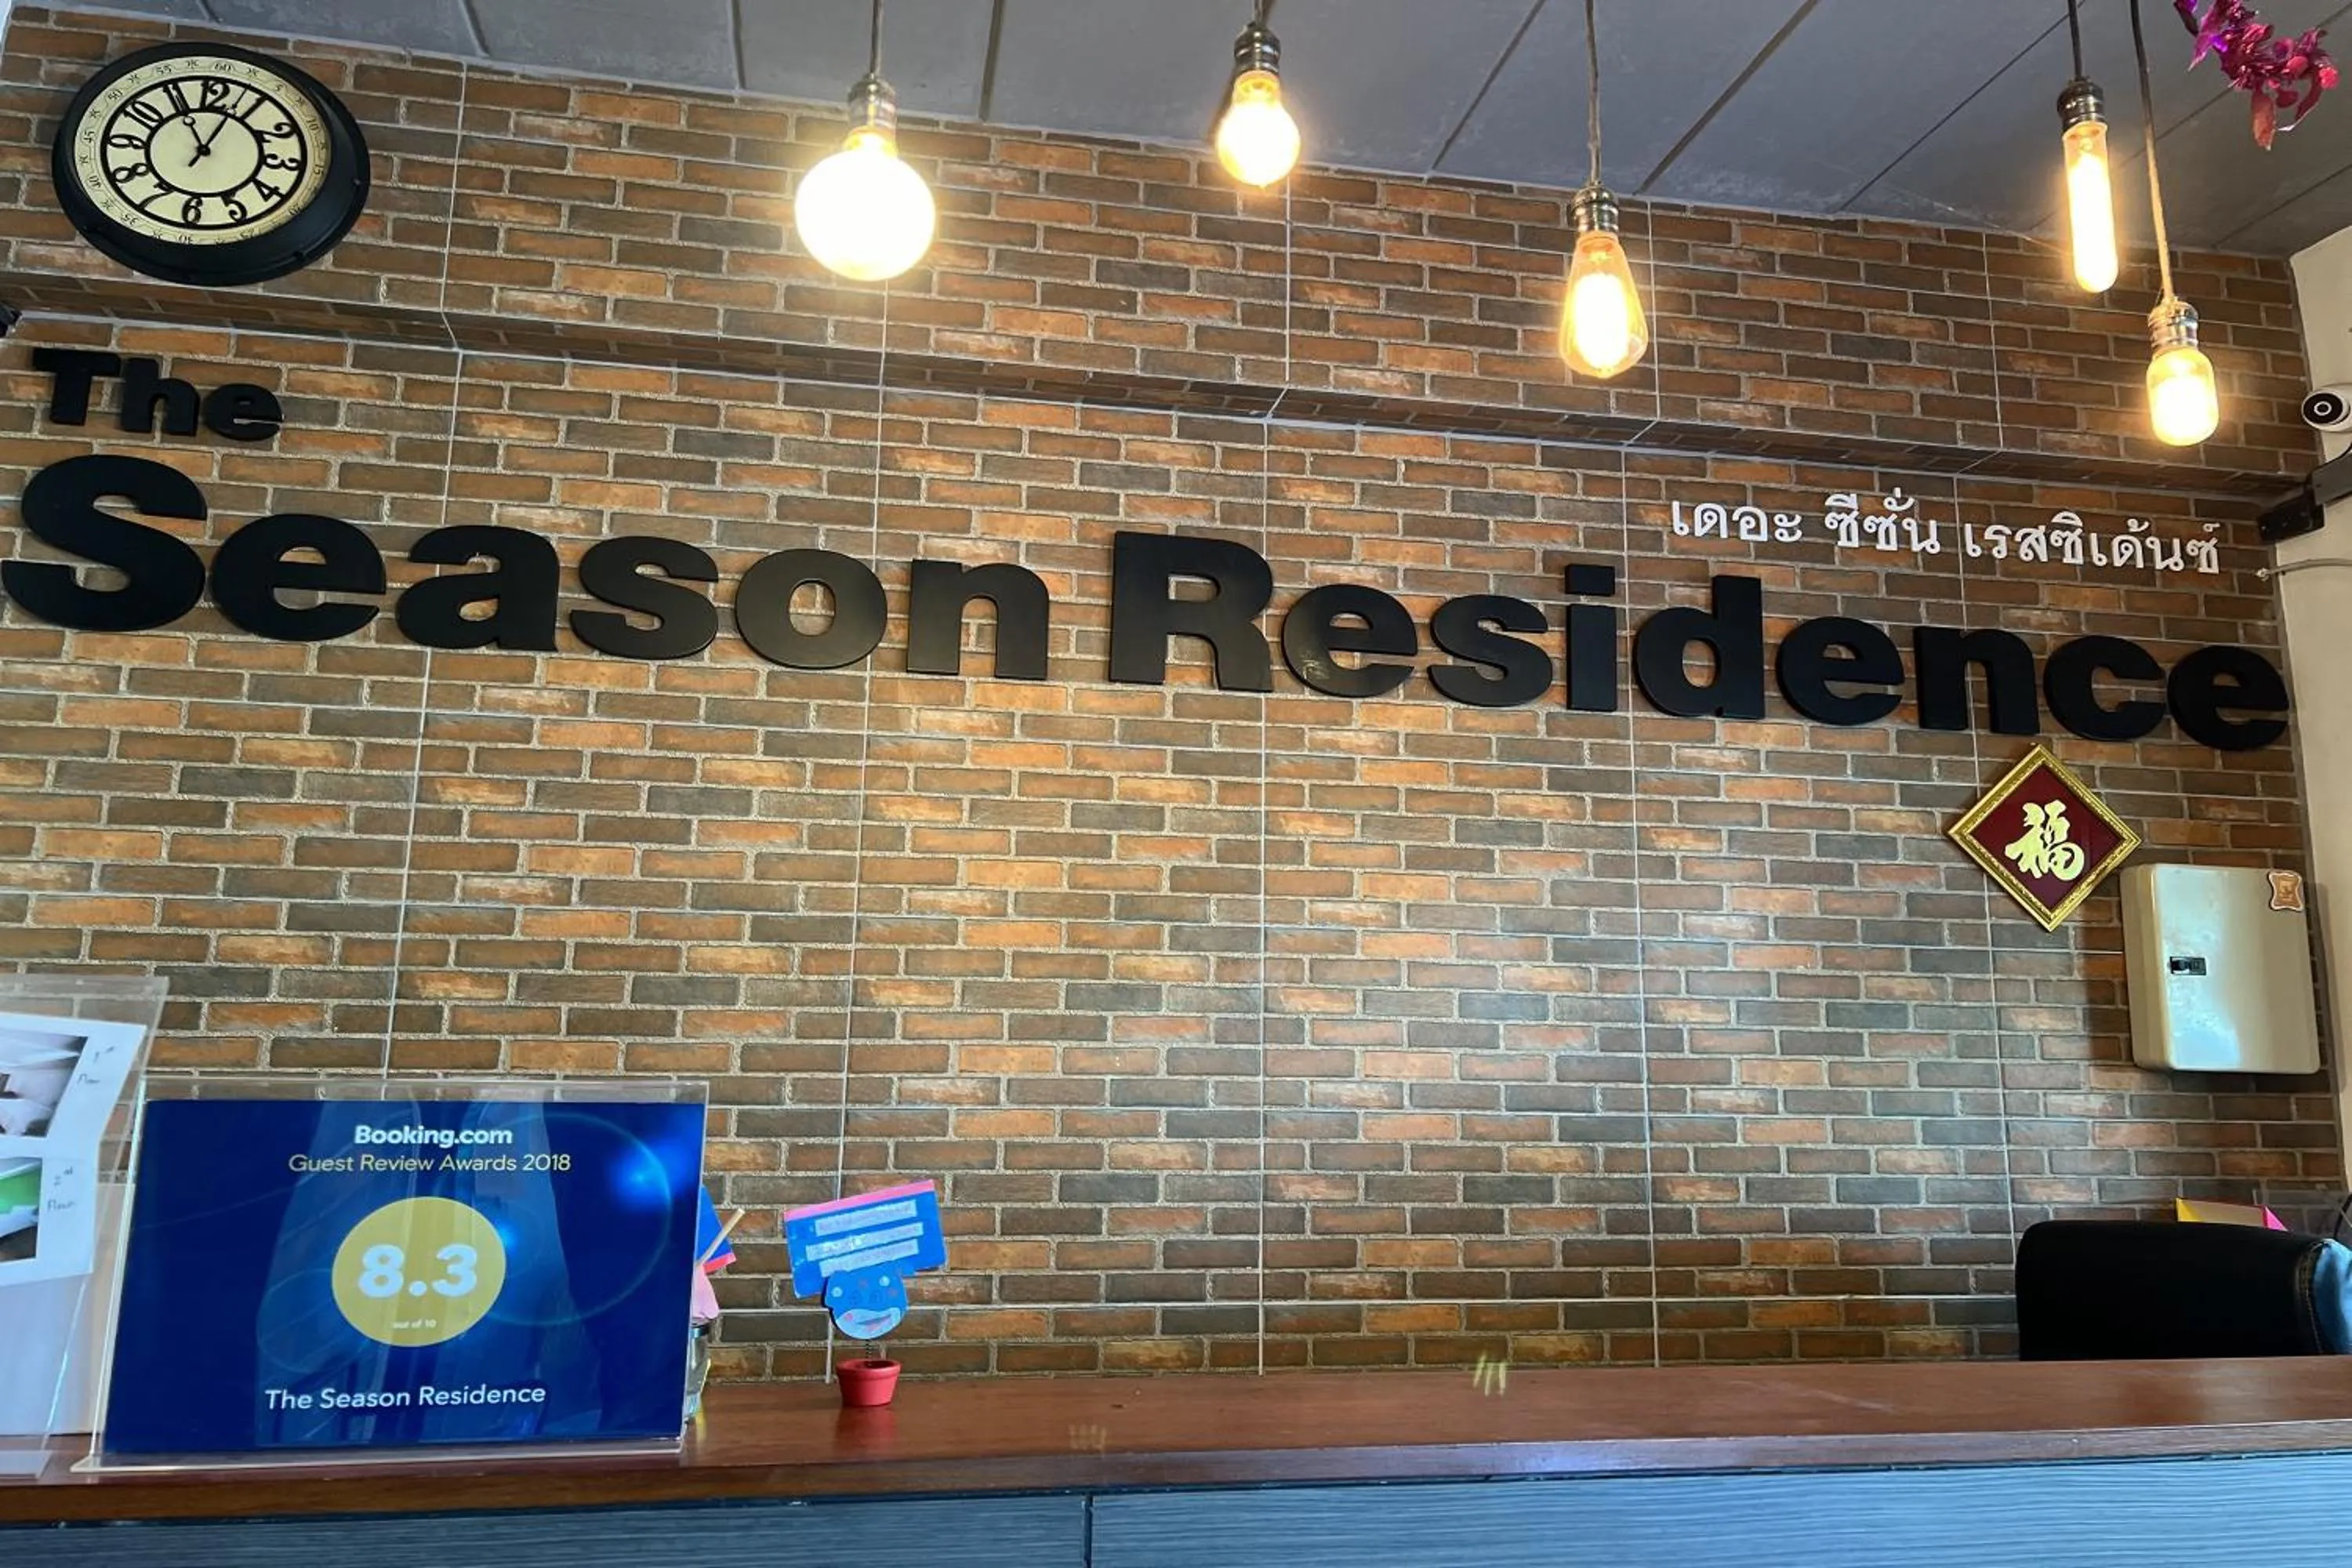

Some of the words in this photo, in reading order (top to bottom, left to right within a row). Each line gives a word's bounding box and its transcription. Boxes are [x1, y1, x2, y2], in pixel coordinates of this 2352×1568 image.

[162, 82, 190, 114] 11
[201, 79, 229, 111] 12
[239, 95, 269, 121] 1
[123, 100, 163, 130] 10
[108, 134, 147, 149] 9
[254, 122, 297, 143] 2
[112, 162, 150, 184] 8
[263, 154, 300, 171] 3
[138, 181, 174, 209] 7
[252, 180, 285, 202] 4
[182, 196, 202, 224] 6
[220, 195, 248, 221] 5
[33, 347, 284, 441] The
[1671, 500, 1802, 543] เดอะ
[1824, 487, 1941, 555] ซีซั่น
[1964, 510, 2220, 574] เรสซิเด้นซ์
[2, 454, 1050, 681] Season
[1109, 531, 2290, 751] Residence
[2004, 798, 2086, 882] 福
[354, 1125, 513, 1149] Booking.com
[288, 1153, 354, 1172] Guest
[359, 1153, 434, 1172] Review
[438, 1153, 517, 1172] Awards
[522, 1153, 572, 1172] 2018
[358, 1243, 477, 1298] 8.3
[392, 1321, 409, 1330] out
[412, 1319, 423, 1329] of
[425, 1319, 437, 1329] 10
[265, 1388, 313, 1410] The
[319, 1387, 410, 1410] Season
[418, 1383, 546, 1406] Residence
